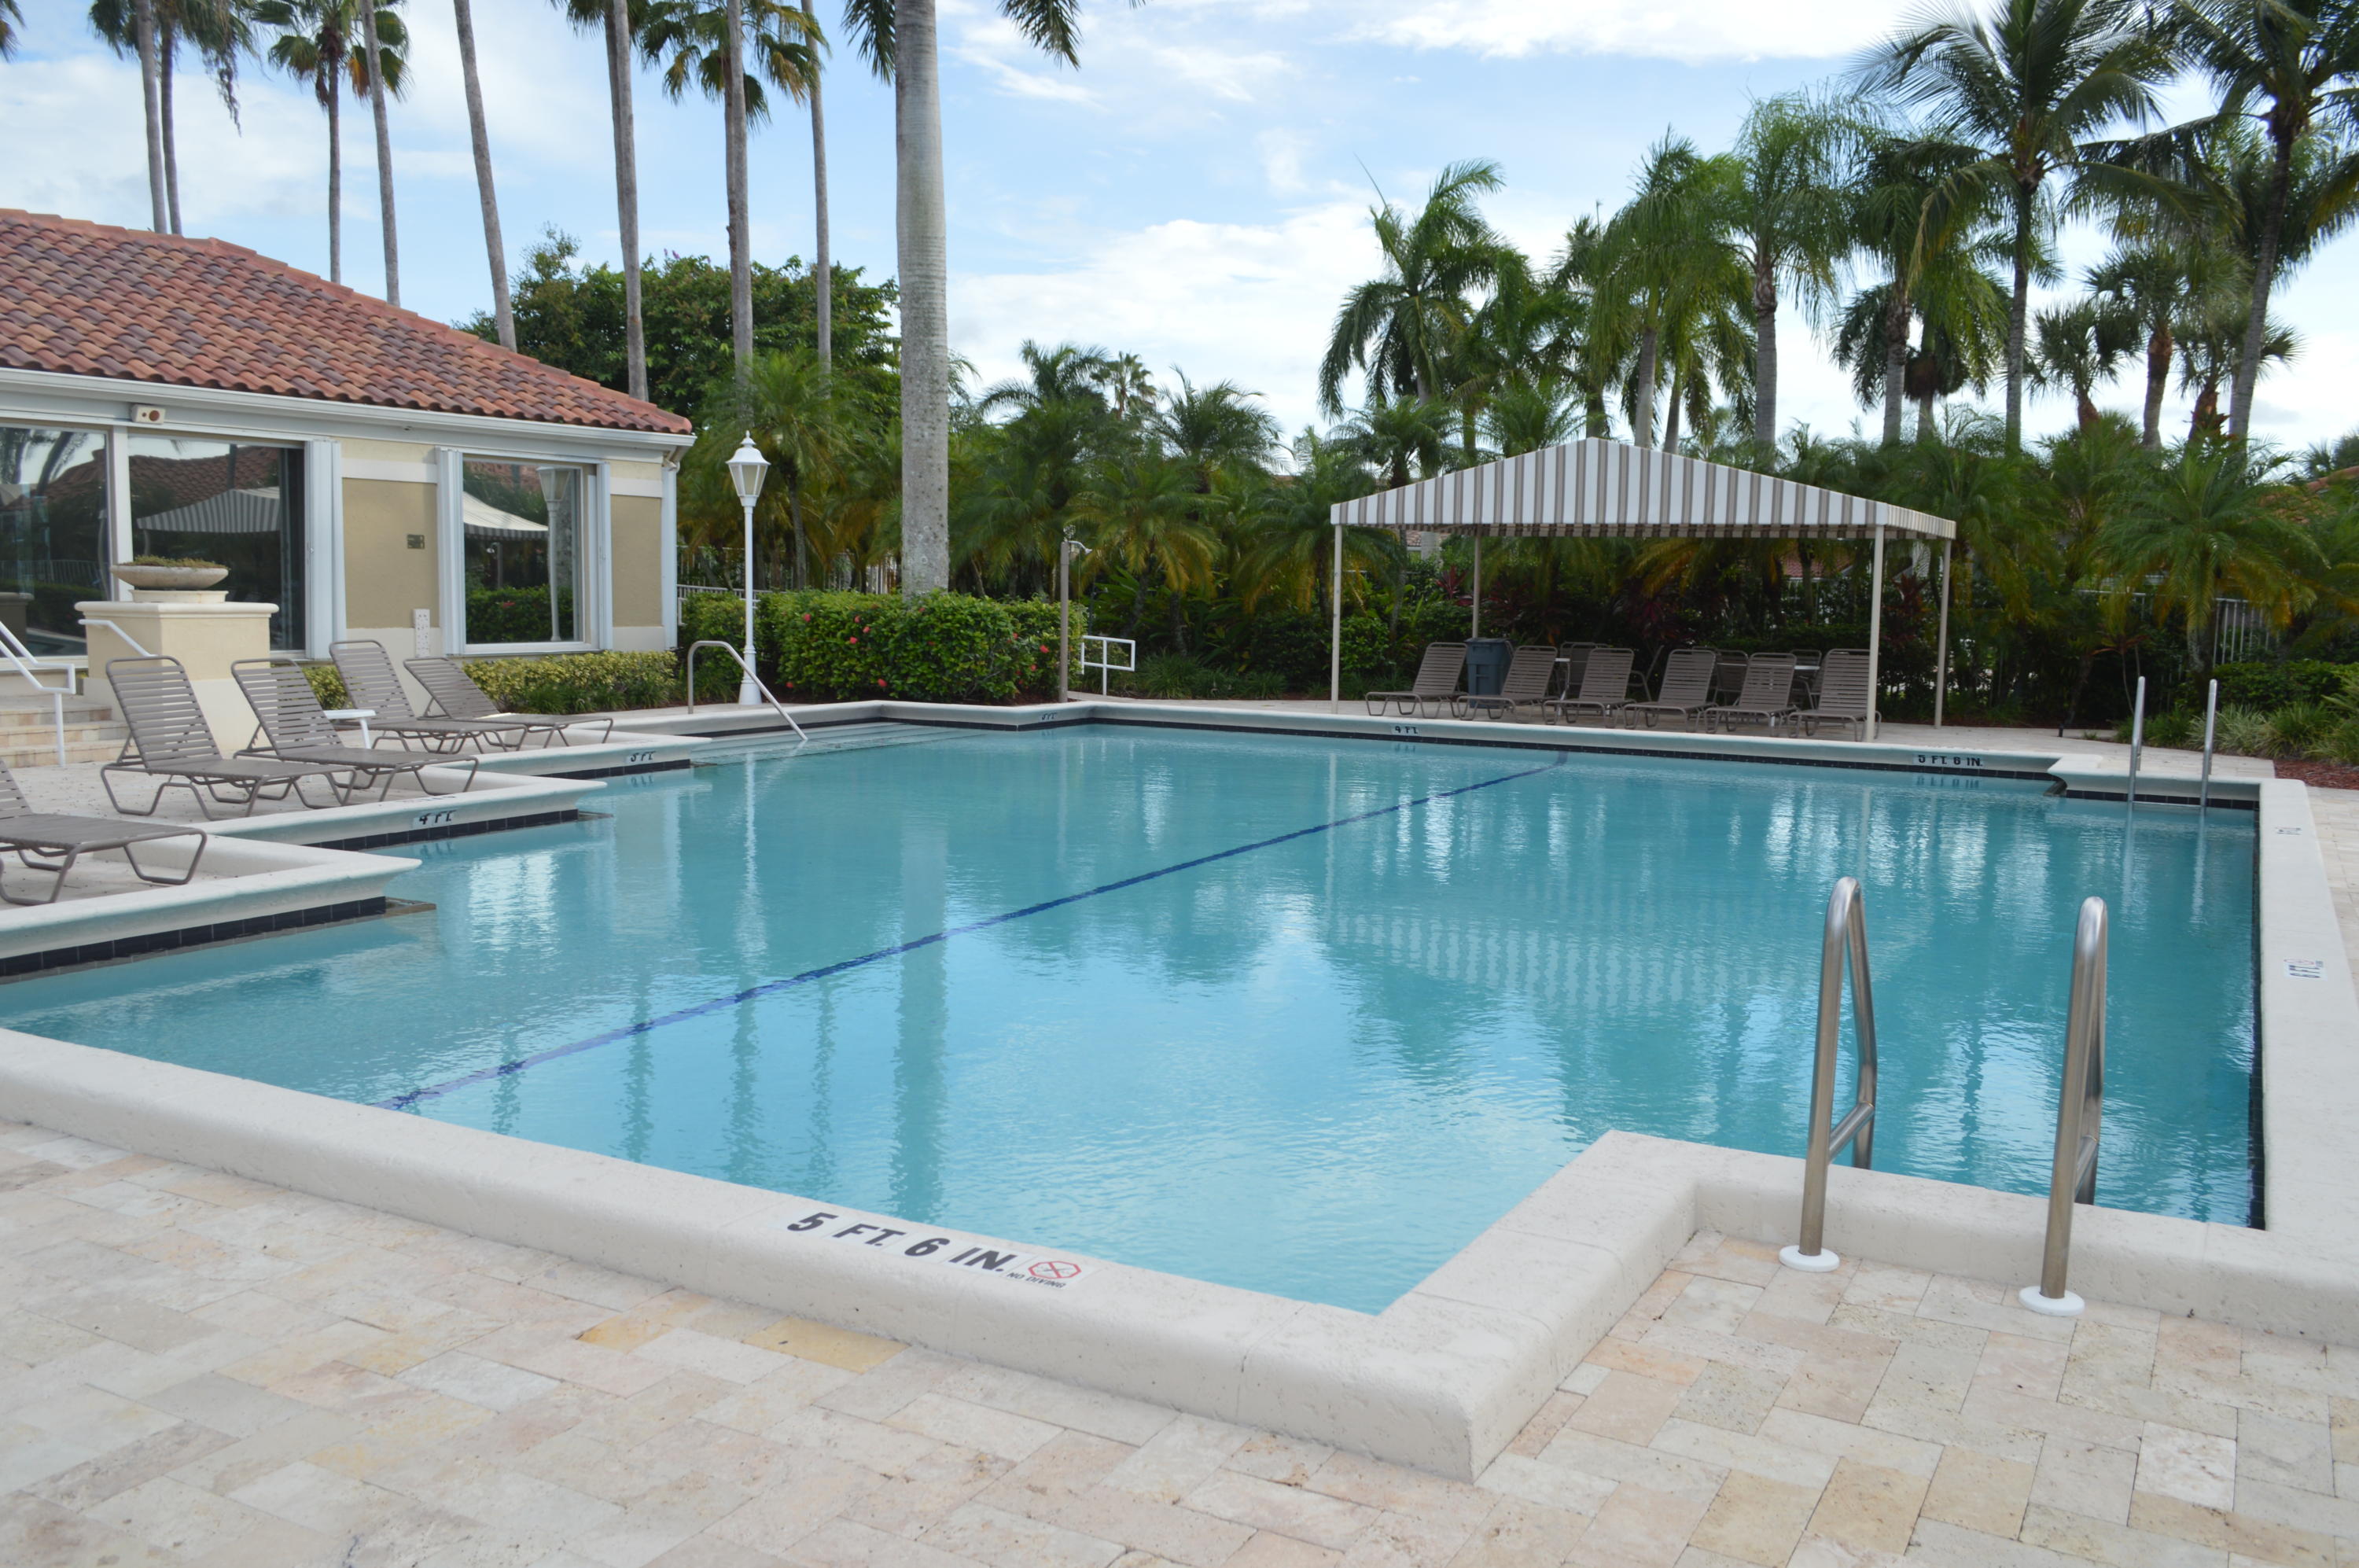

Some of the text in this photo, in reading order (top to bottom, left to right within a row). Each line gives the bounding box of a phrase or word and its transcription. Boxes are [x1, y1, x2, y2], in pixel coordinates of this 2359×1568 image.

[1918, 754, 1984, 767] 5 FT. 6 IN.
[418, 812, 432, 825] 4
[786, 1212, 1018, 1273] 5 FT. 6 IN.
[1007, 1272, 1067, 1289] NO DIVING
